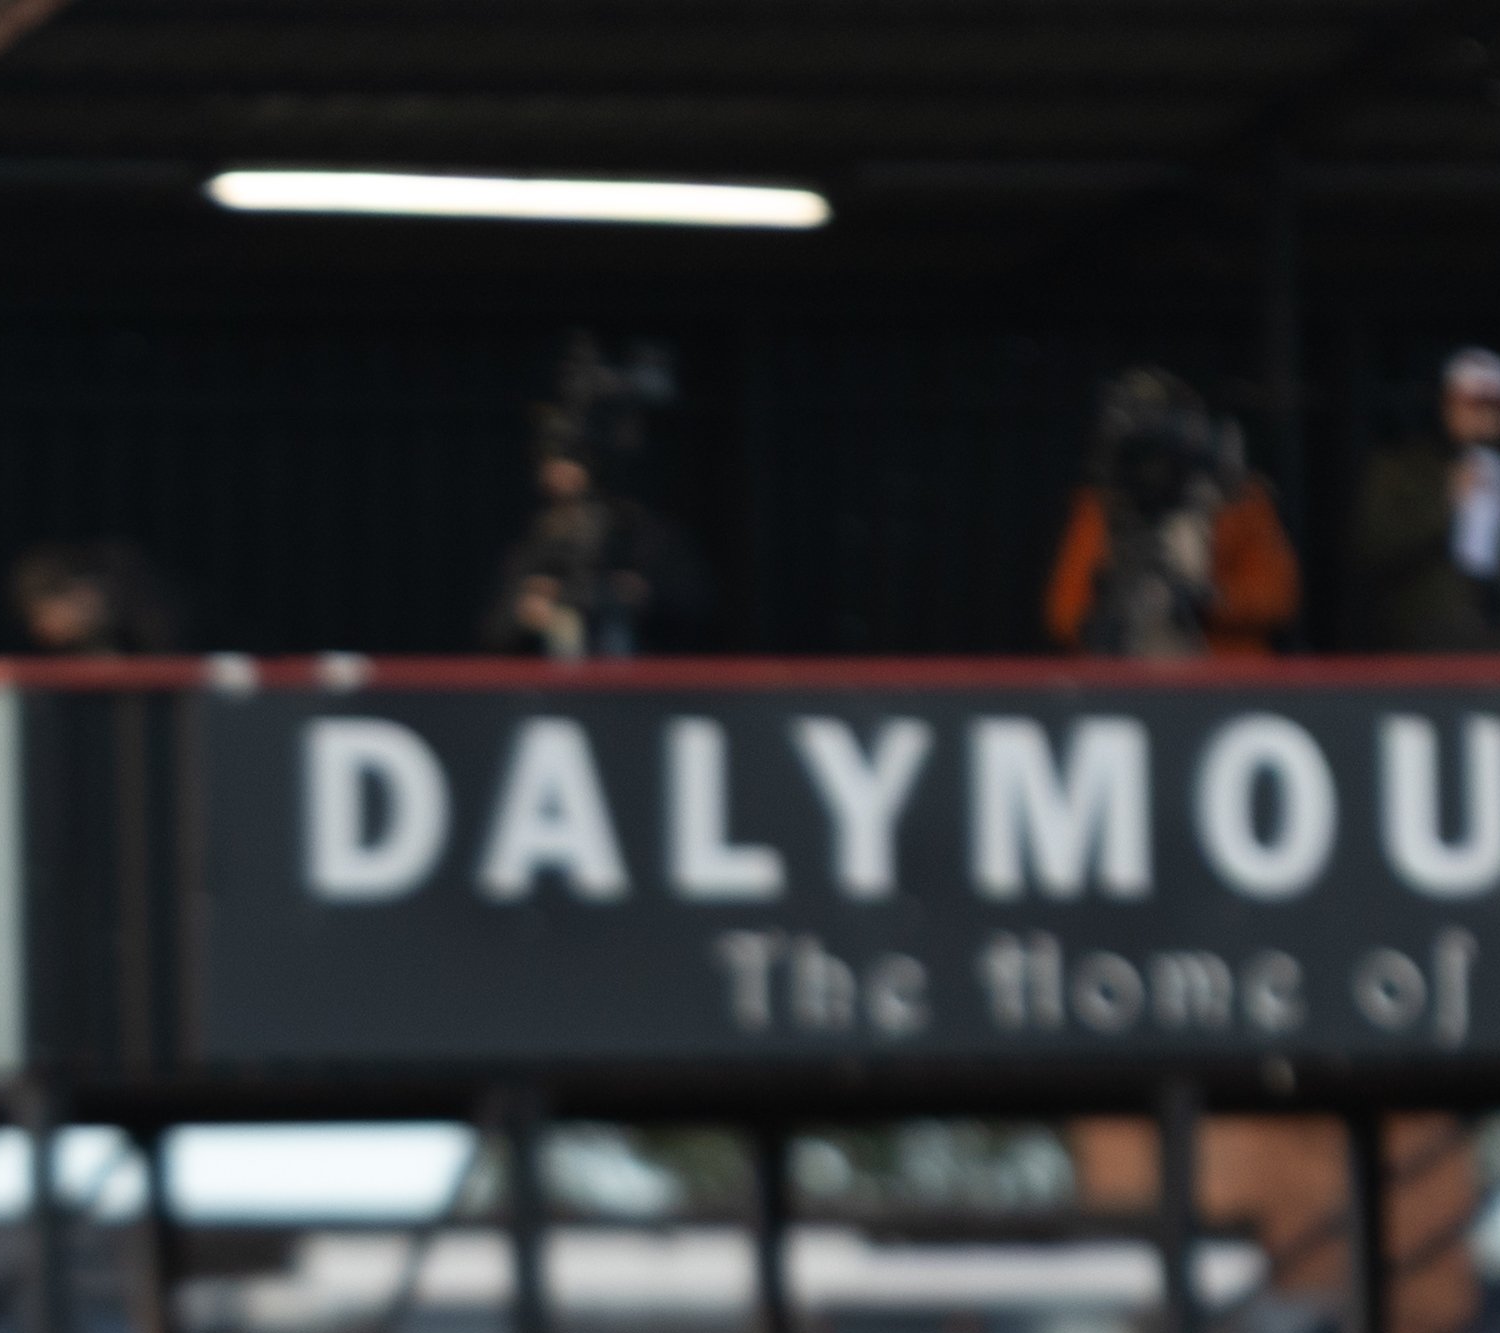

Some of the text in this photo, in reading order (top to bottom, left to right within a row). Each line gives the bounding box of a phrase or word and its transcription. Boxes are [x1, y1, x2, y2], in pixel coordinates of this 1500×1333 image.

[714, 928, 930, 1036] The
[980, 926, 1308, 1036] Home
[1354, 926, 1478, 1050] of
